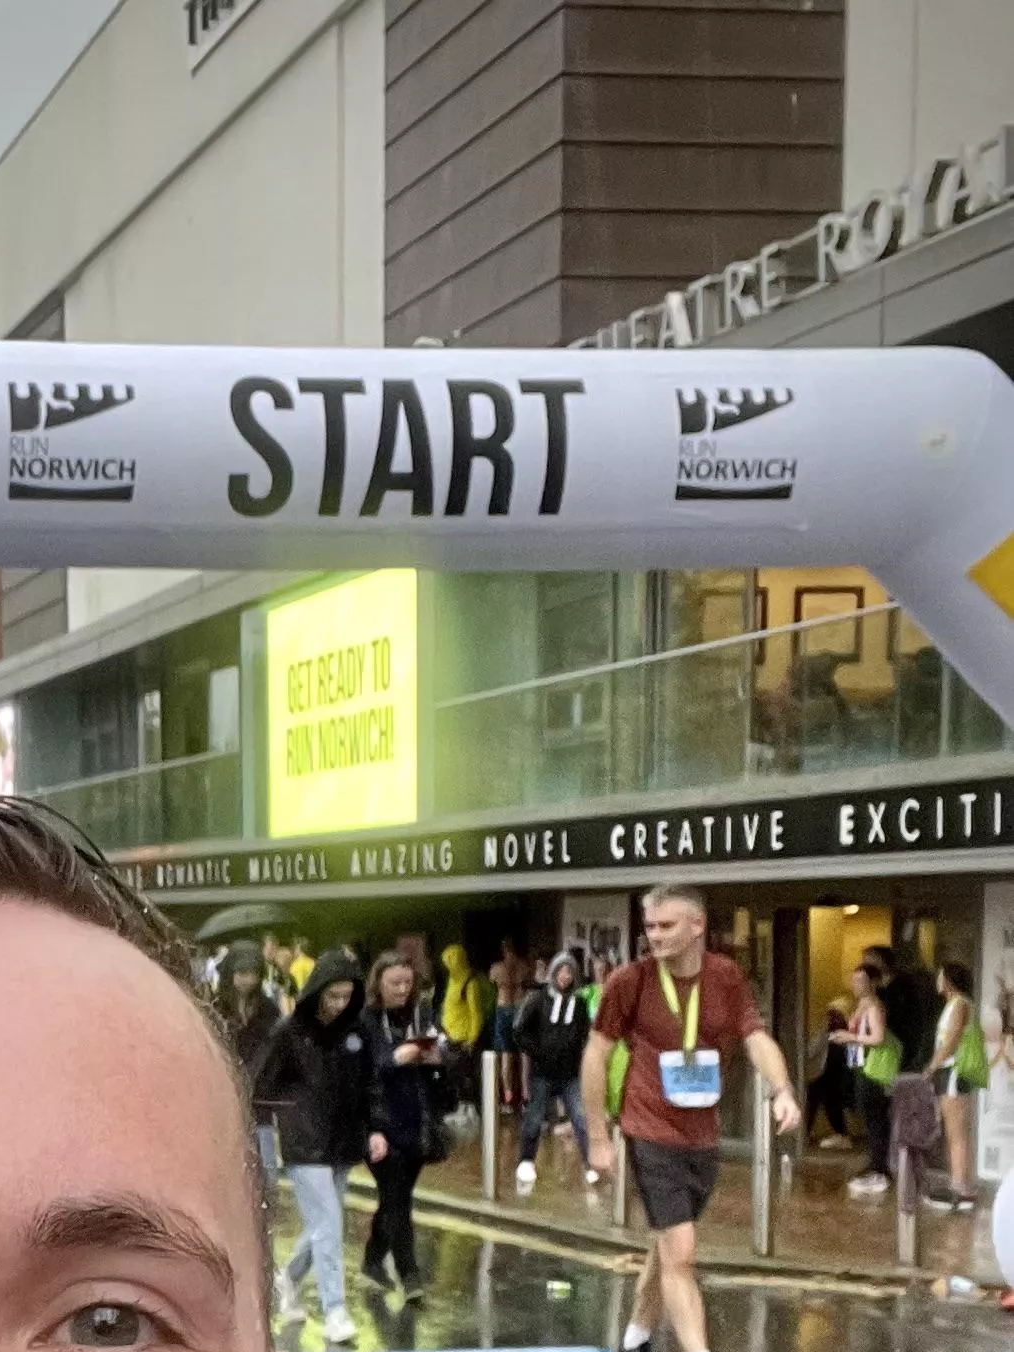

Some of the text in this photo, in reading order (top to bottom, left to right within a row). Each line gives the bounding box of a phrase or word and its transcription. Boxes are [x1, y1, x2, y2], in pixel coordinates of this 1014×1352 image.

[567, 242, 782, 348] HEATRE
[9, 436, 49, 456] RUN
[9, 458, 136, 480] NORWICH
[227, 376, 586, 516] START
[678, 459, 797, 479] NORWICH
[287, 635, 391, 715] GET READY TO
[286, 704, 394, 778] RUN NORWICH!
[248, 851, 328, 884] MAGICAL
[349, 838, 454, 877] AMAZING
[484, 829, 572, 869] NOVEL
[609, 809, 785, 860] CREATIVE
[838, 791, 1003, 847] EXCITI
